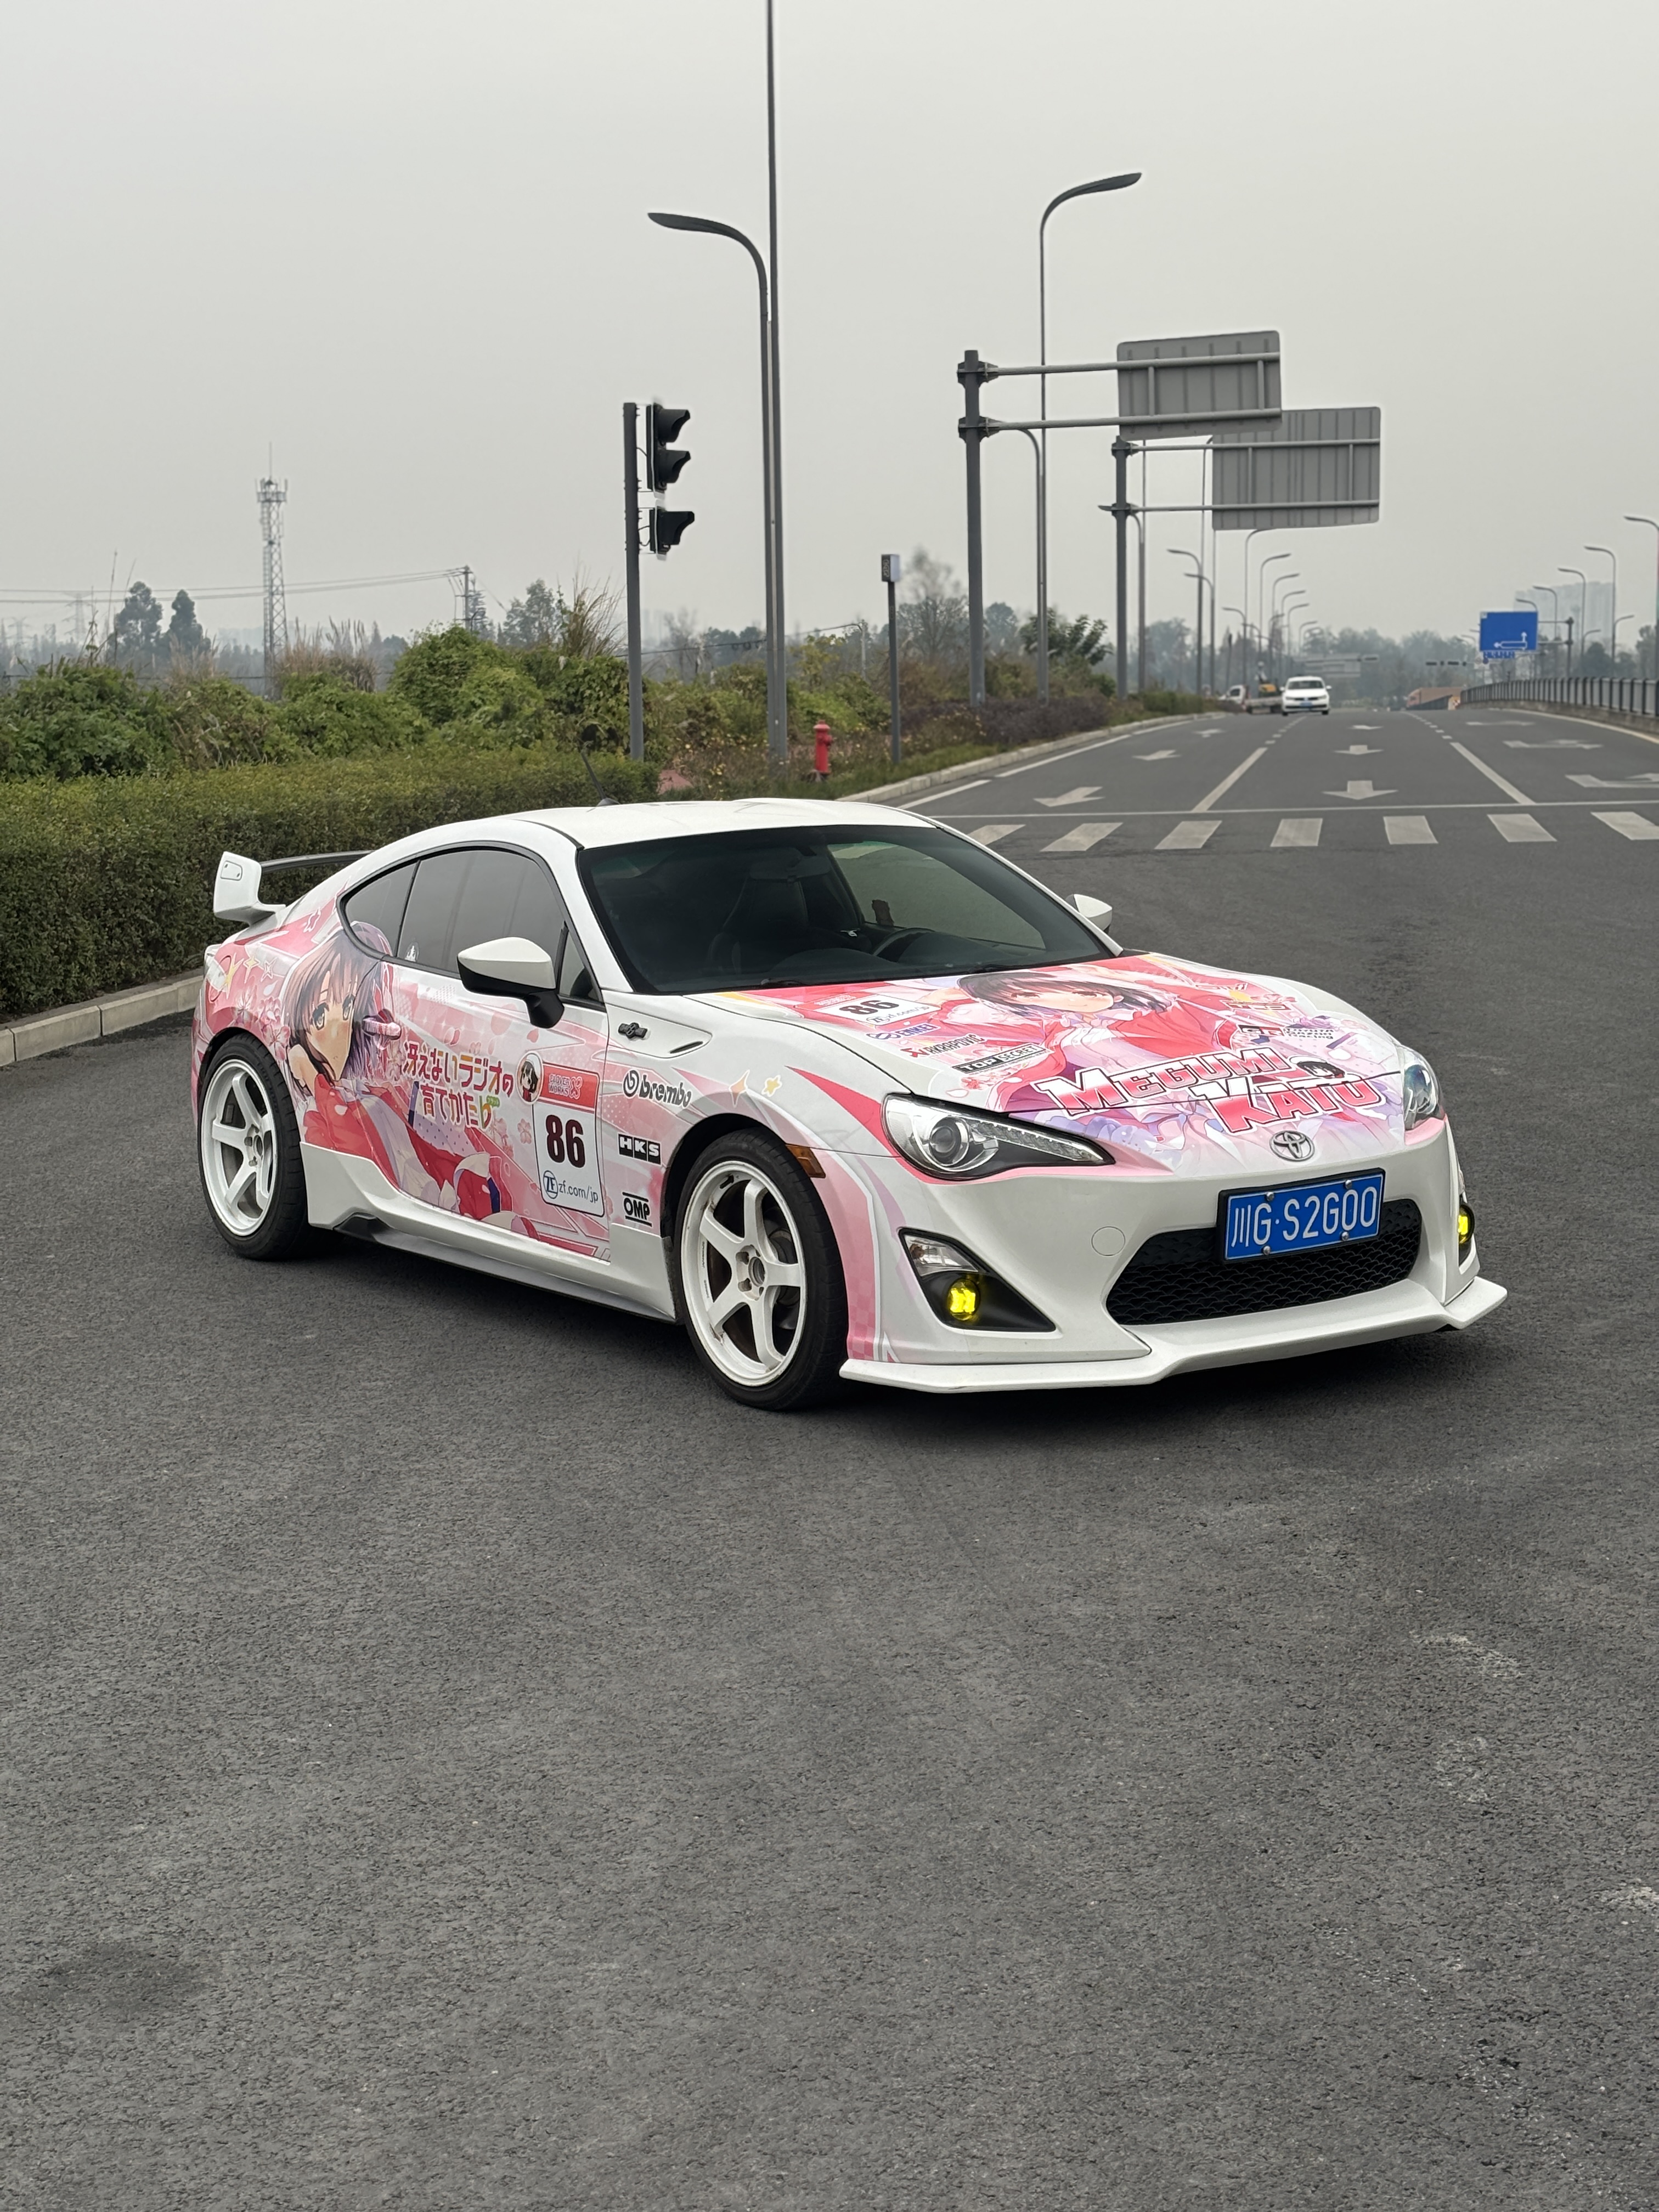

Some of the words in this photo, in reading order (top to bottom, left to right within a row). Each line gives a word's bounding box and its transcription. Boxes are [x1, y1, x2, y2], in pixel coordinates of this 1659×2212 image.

[839, 1000, 900, 1015] 86
[894, 1024, 939, 1036] ENKEI
[960, 1057, 997, 1071] TOP
[997, 1046, 1039, 1061] SECRET
[639, 1074, 692, 1108] brembo
[1036, 1046, 1291, 1114] MEGUMI
[1188, 1072, 1383, 1133] KATO
[545, 1114, 586, 1168] 86
[619, 1137, 660, 1157] HKS
[558, 1182, 599, 1204] zf.com/jp
[623, 1197, 650, 1220] OMP
